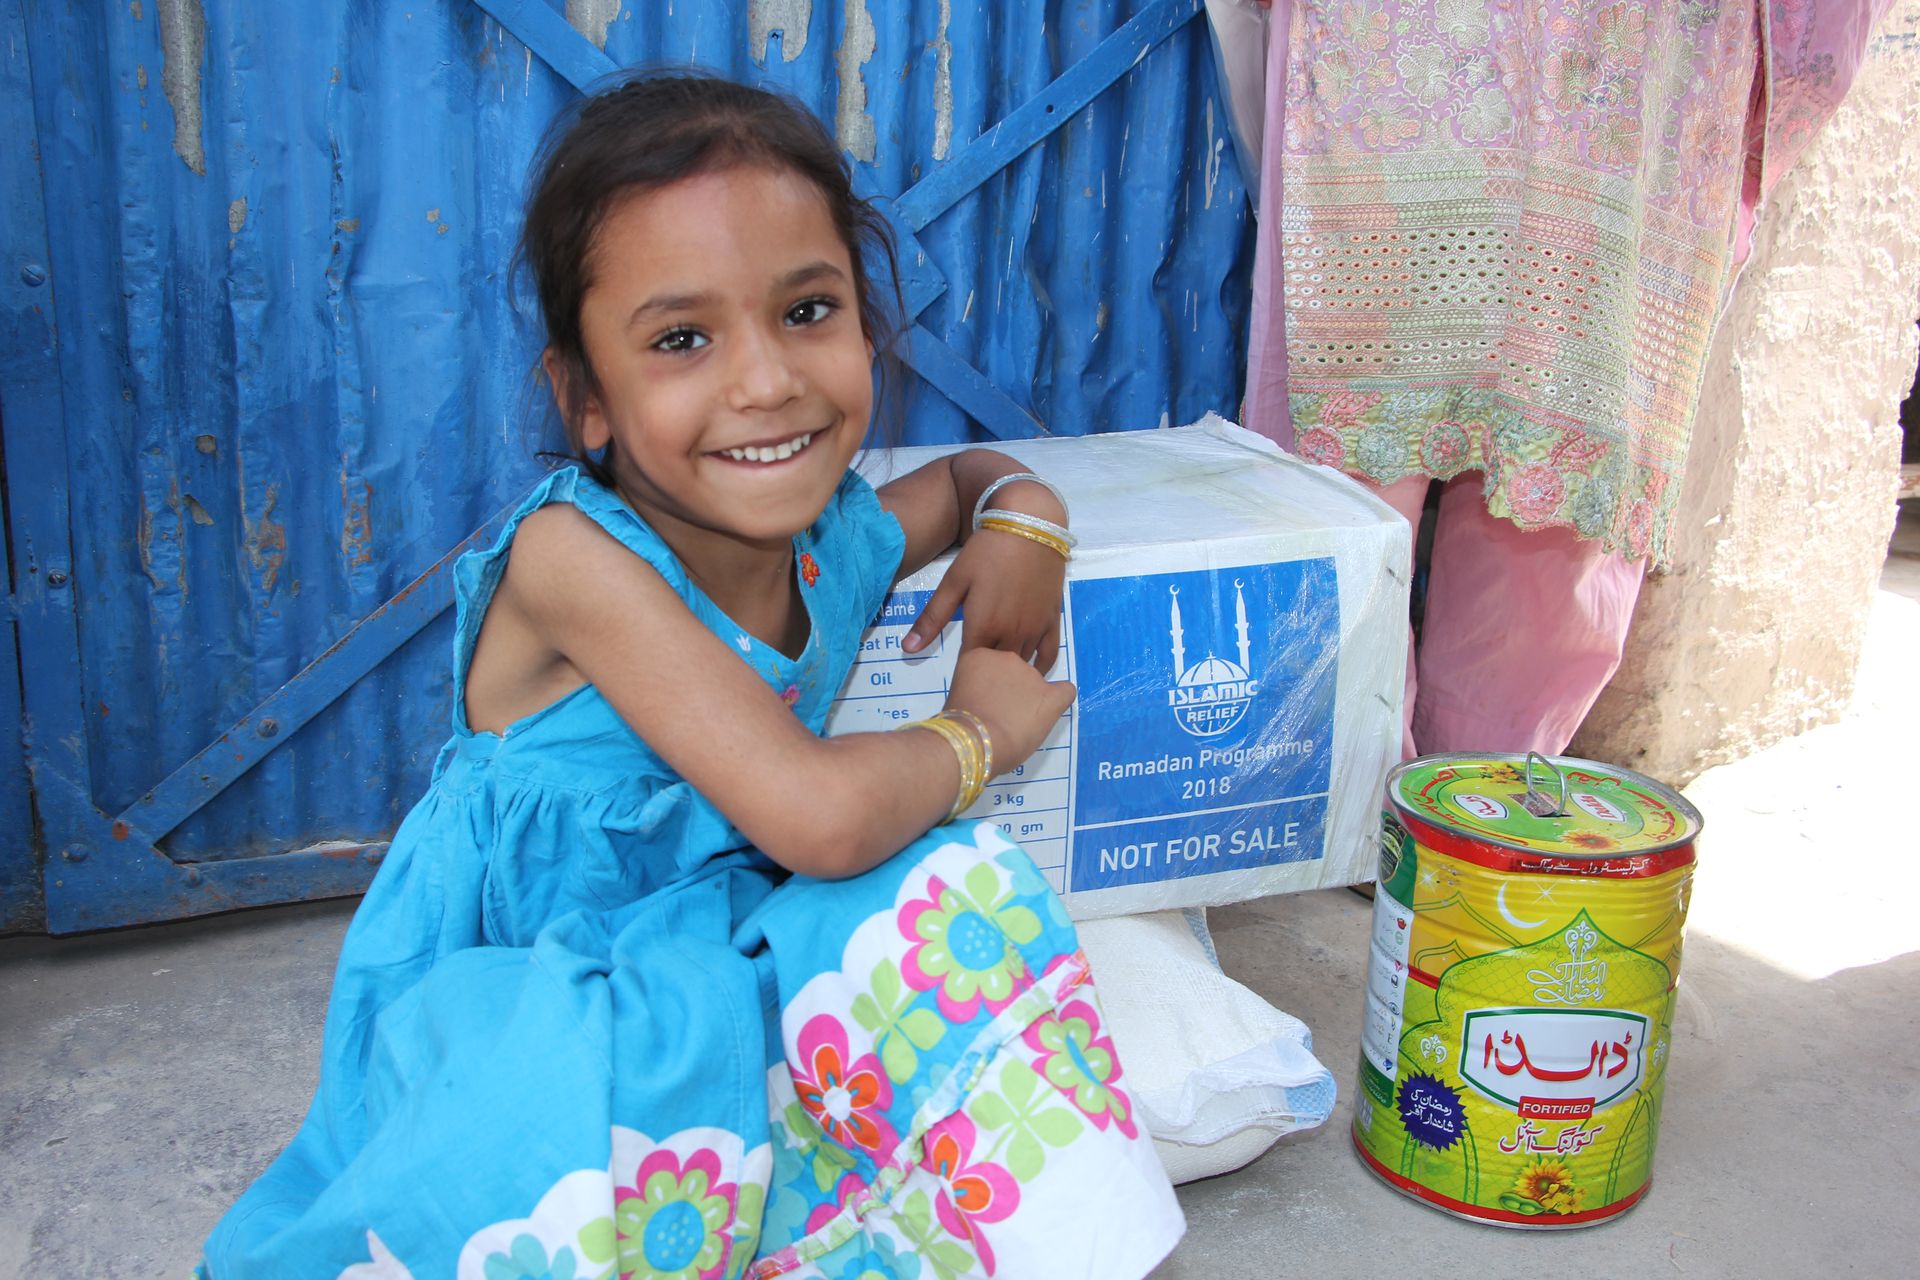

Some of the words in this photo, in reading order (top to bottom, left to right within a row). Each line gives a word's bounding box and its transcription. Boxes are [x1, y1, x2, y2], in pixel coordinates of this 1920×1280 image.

[870, 672, 892, 686] Oil
[1168, 679, 1260, 706] ISLAMIC
[1186, 704, 1240, 723] RELIEF
[1008, 763, 1025, 776] g
[1098, 754, 1193, 781] Ramadan
[1199, 738, 1314, 769] Programme
[1182, 775, 1232, 800] 2018
[993, 794, 1003, 806] 3
[1006, 793, 1025, 806] kg
[1021, 823, 1044, 835] gm
[1099, 842, 1159, 873] NOT
[1165, 833, 1221, 865] FOR
[1228, 822, 1301, 855] SALE
[1483, 1030, 1633, 1083] ڈالڈا
[1410, 1088, 1425, 1101] کی
[1404, 1103, 1427, 1121] آفر
[1420, 1096, 1452, 1116] رمضان
[1521, 1102, 1591, 1115] FORTIFIED
[1422, 1112, 1455, 1133] شاندار
[1499, 1120, 1545, 1153] آئل
[1530, 1126, 1604, 1154] کوکنگ
